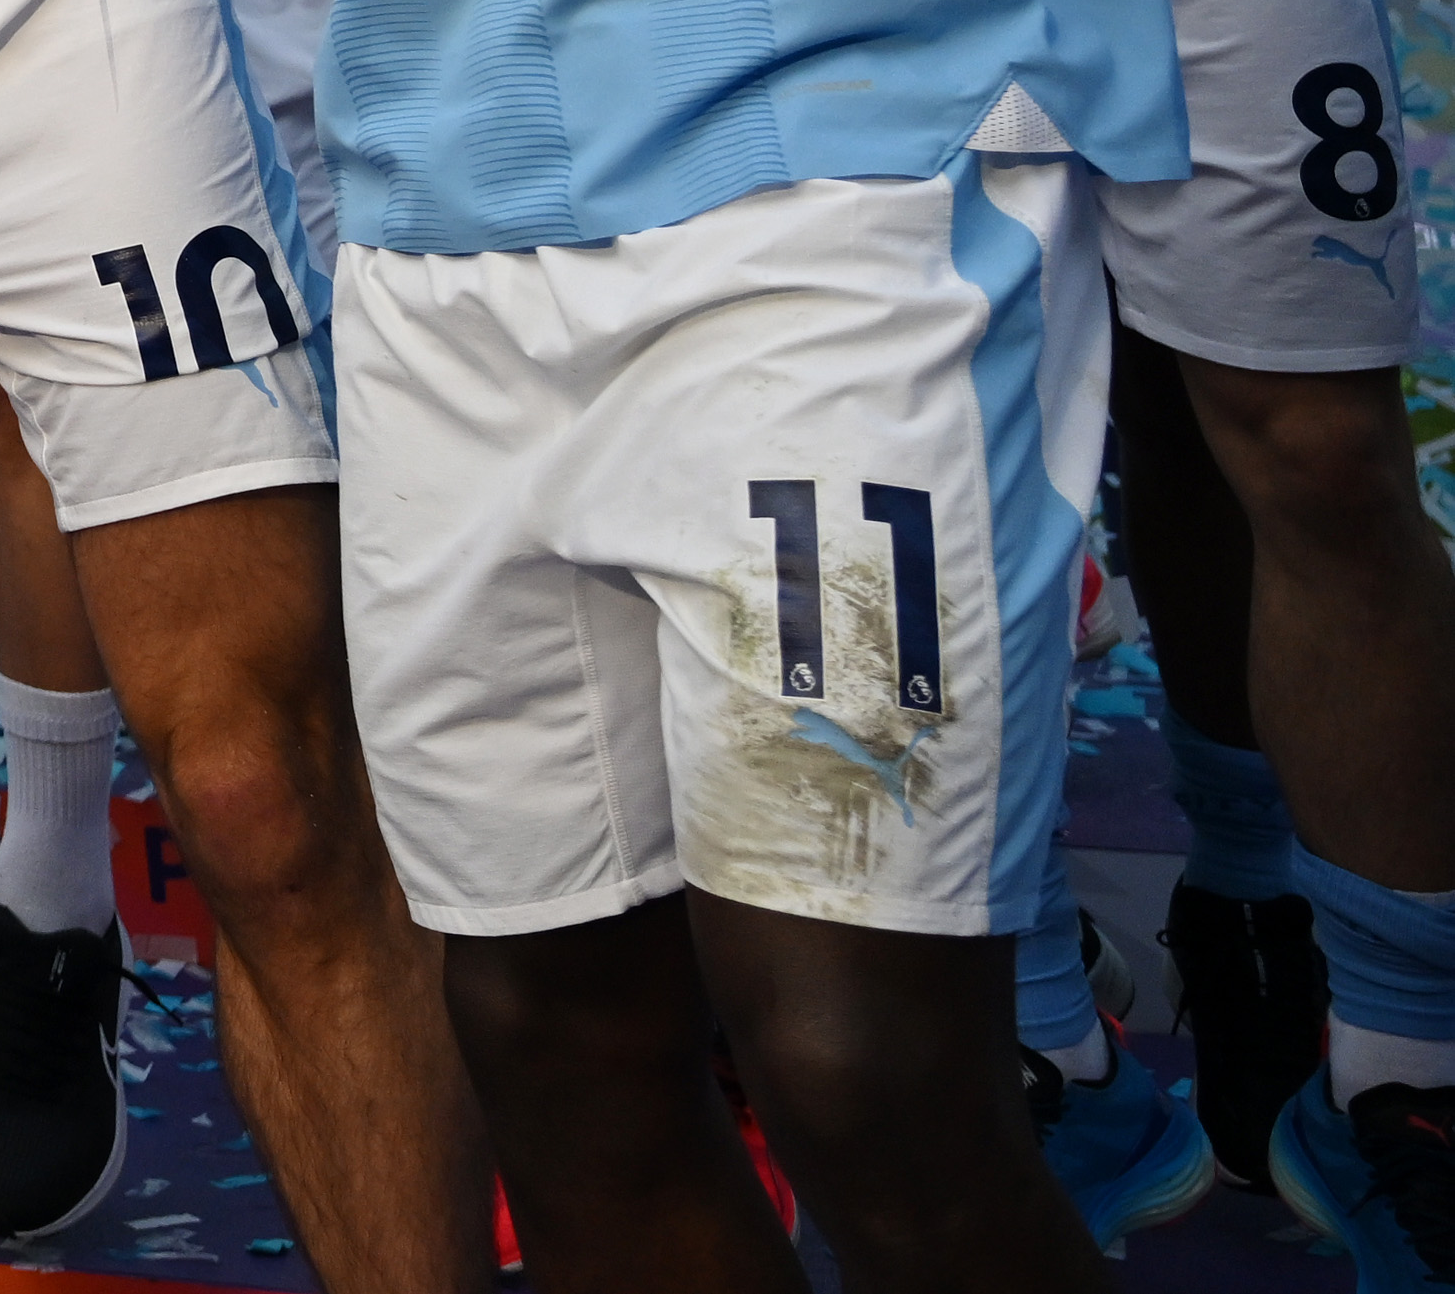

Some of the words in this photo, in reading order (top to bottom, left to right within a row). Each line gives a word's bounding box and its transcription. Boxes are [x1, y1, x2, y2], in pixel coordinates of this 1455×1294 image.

[1292, 63, 1397, 222] 8
[92, 224, 299, 382] 10
[748, 478, 943, 715] 11
